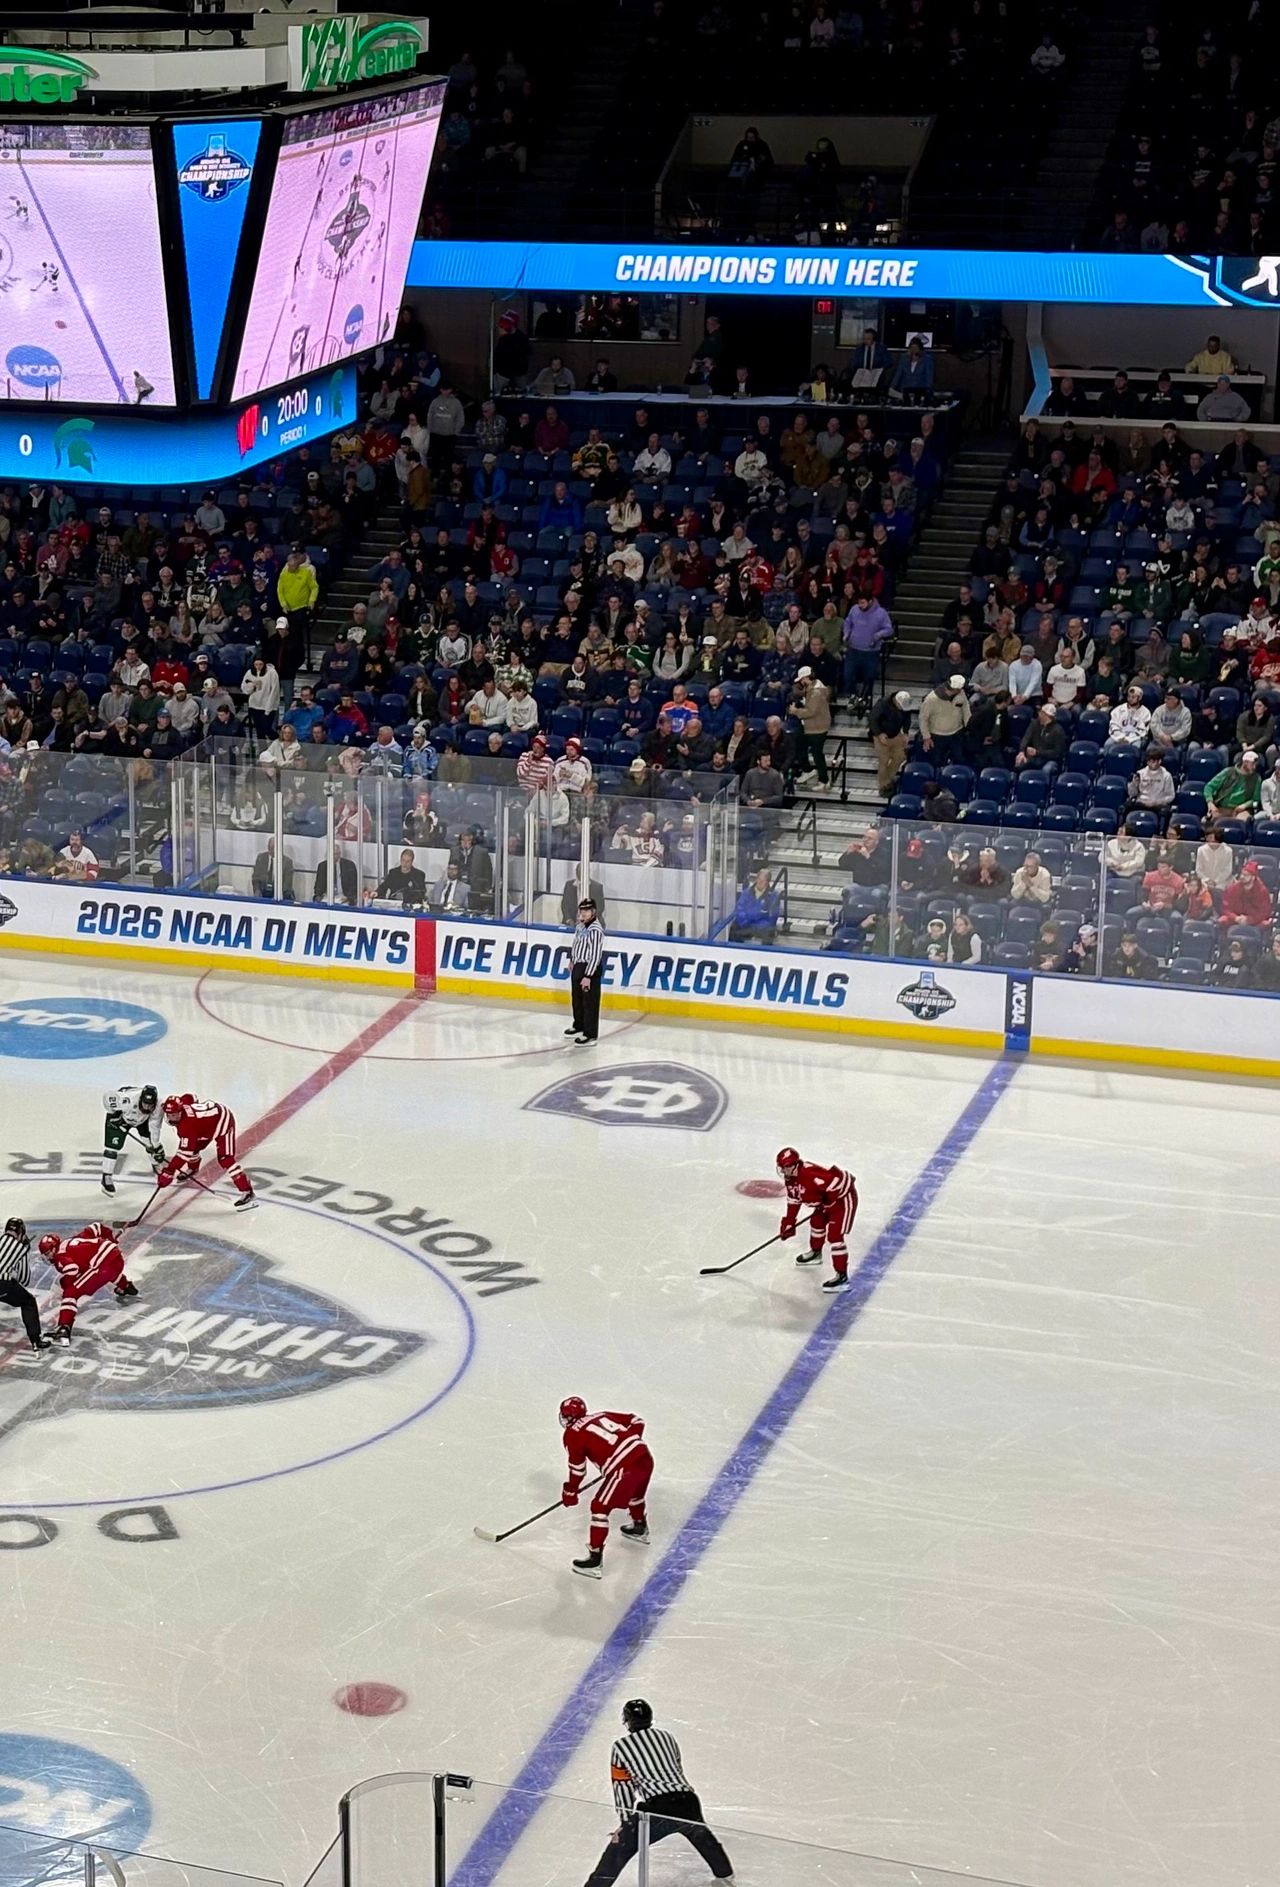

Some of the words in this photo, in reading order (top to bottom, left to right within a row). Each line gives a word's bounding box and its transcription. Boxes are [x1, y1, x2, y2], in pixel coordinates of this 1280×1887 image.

[300, 16, 360, 90] DCU
[365, 43, 419, 78] center
[180, 168, 250, 182] CHAMPIONSHIP
[616, 255, 777, 284] CHAMPIONS
[784, 258, 839, 285] WIN
[845, 259, 918, 287] HERE
[13, 363, 60, 377] NCAA
[262, 416, 269, 436] 0
[277, 388, 308, 425] 20:00
[315, 395, 322, 416] 0
[19, 434, 33, 456] 0
[280, 426, 303, 446] PERIOD
[76, 900, 163, 939] 2026
[169, 909, 253, 949] NCAA
[261, 918, 296, 954] DI
[303, 922, 410, 965] MEN'S
[440, 934, 496, 974] ICE
[502, 941, 642, 988] HOCEY
[647, 955, 850, 1009] REGIONALS
[898, 995, 955, 1009] CHAMPIONSHIP
[1012, 981, 1026, 1025] NCAA
